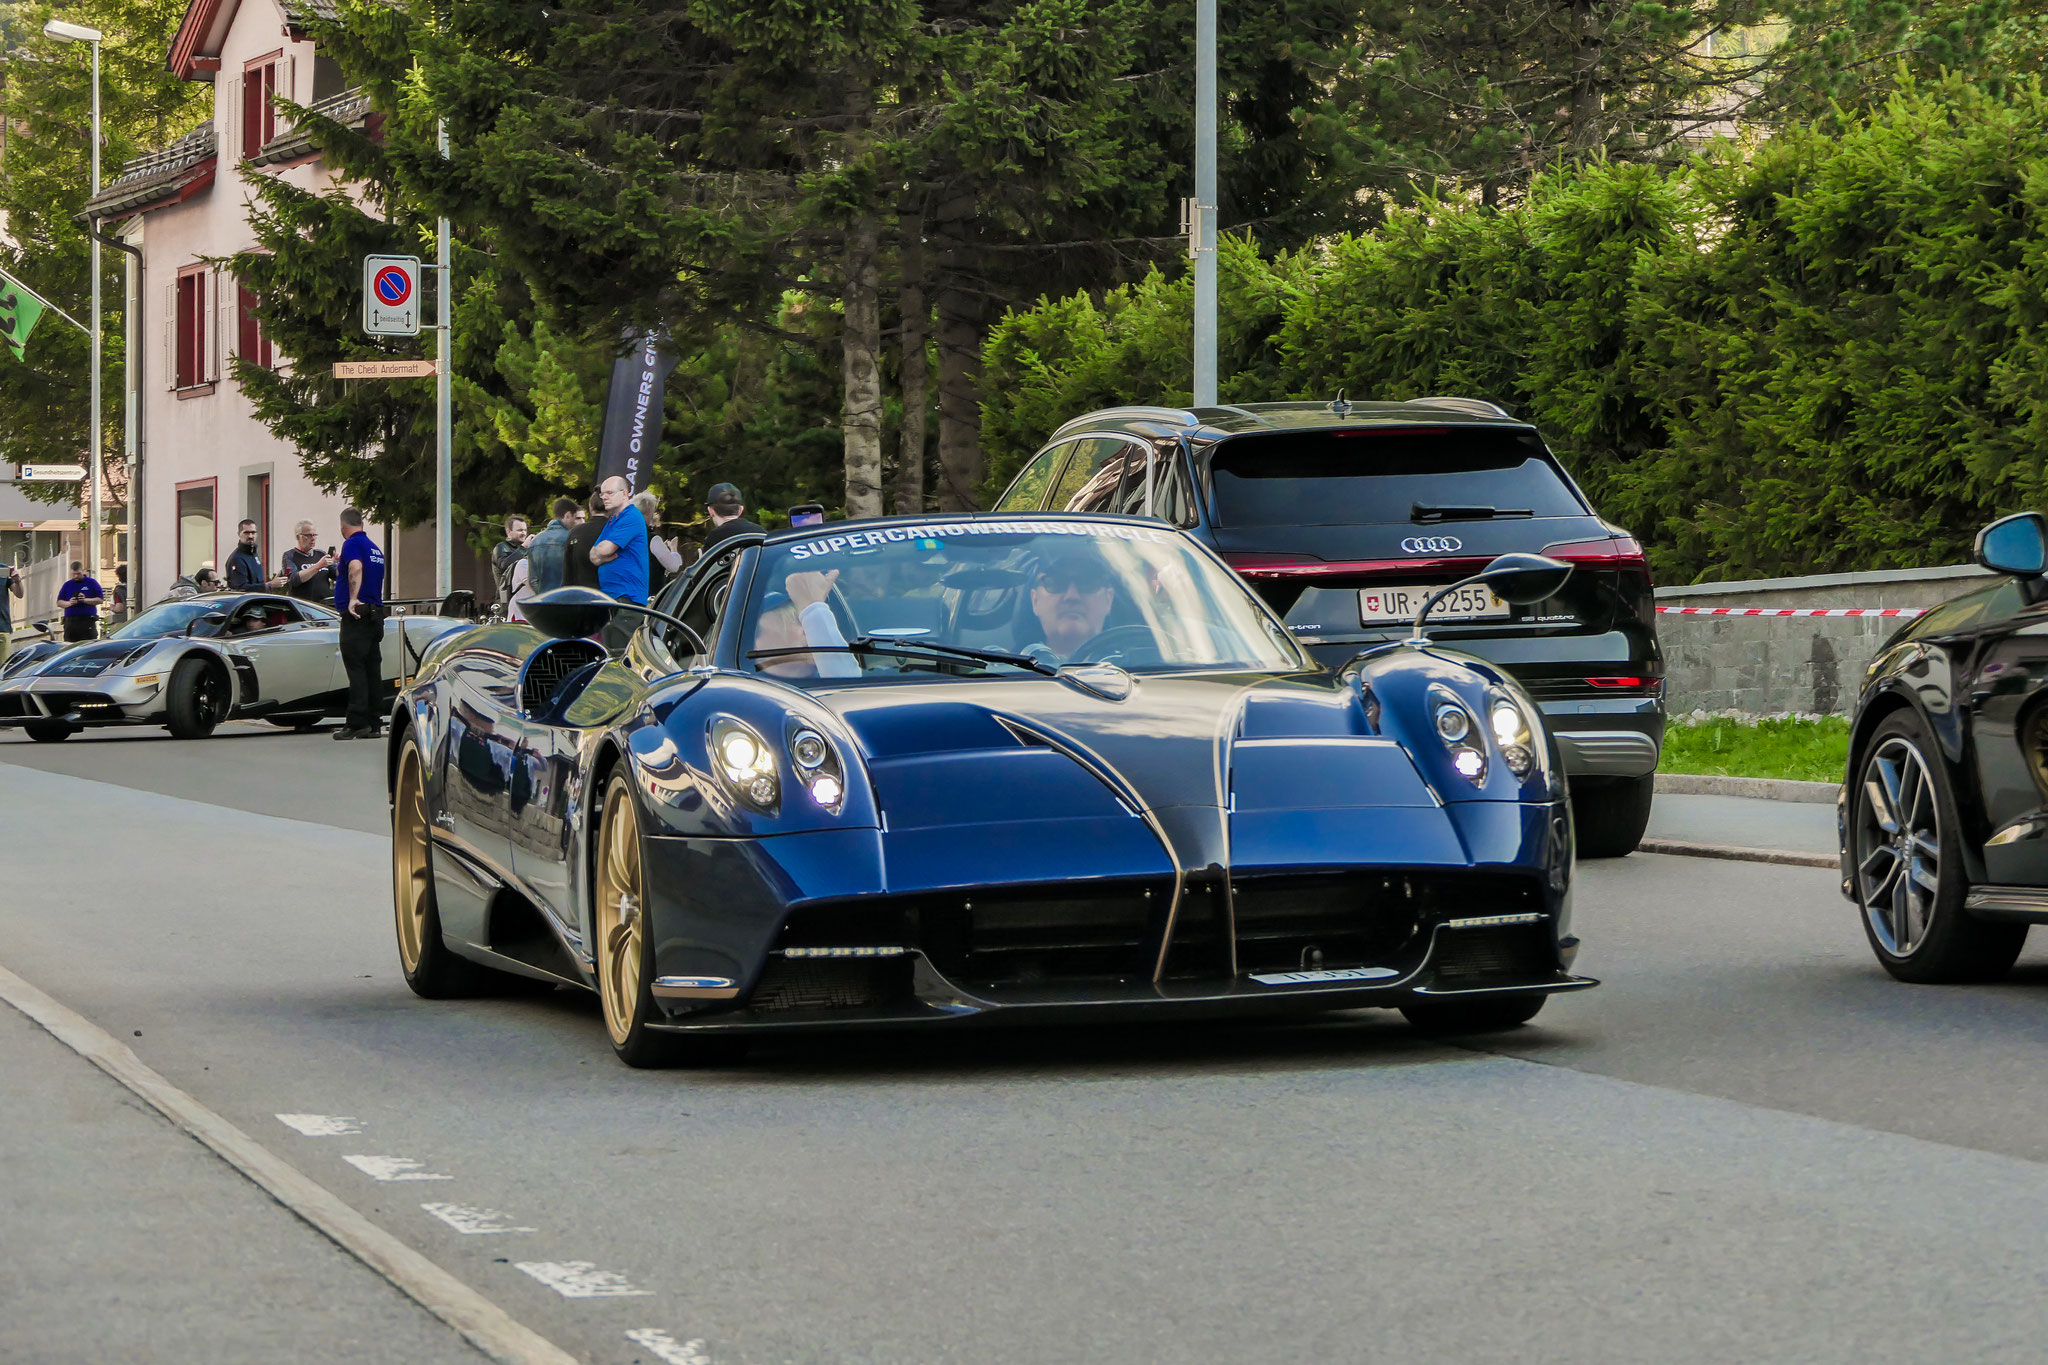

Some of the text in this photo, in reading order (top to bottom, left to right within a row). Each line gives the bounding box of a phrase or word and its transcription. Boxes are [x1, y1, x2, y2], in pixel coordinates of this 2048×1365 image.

[341, 363, 419, 375] The Chedi Andermatt
[630, 371, 655, 454] OWNERS
[1537, 614, 1575, 622] quattro
